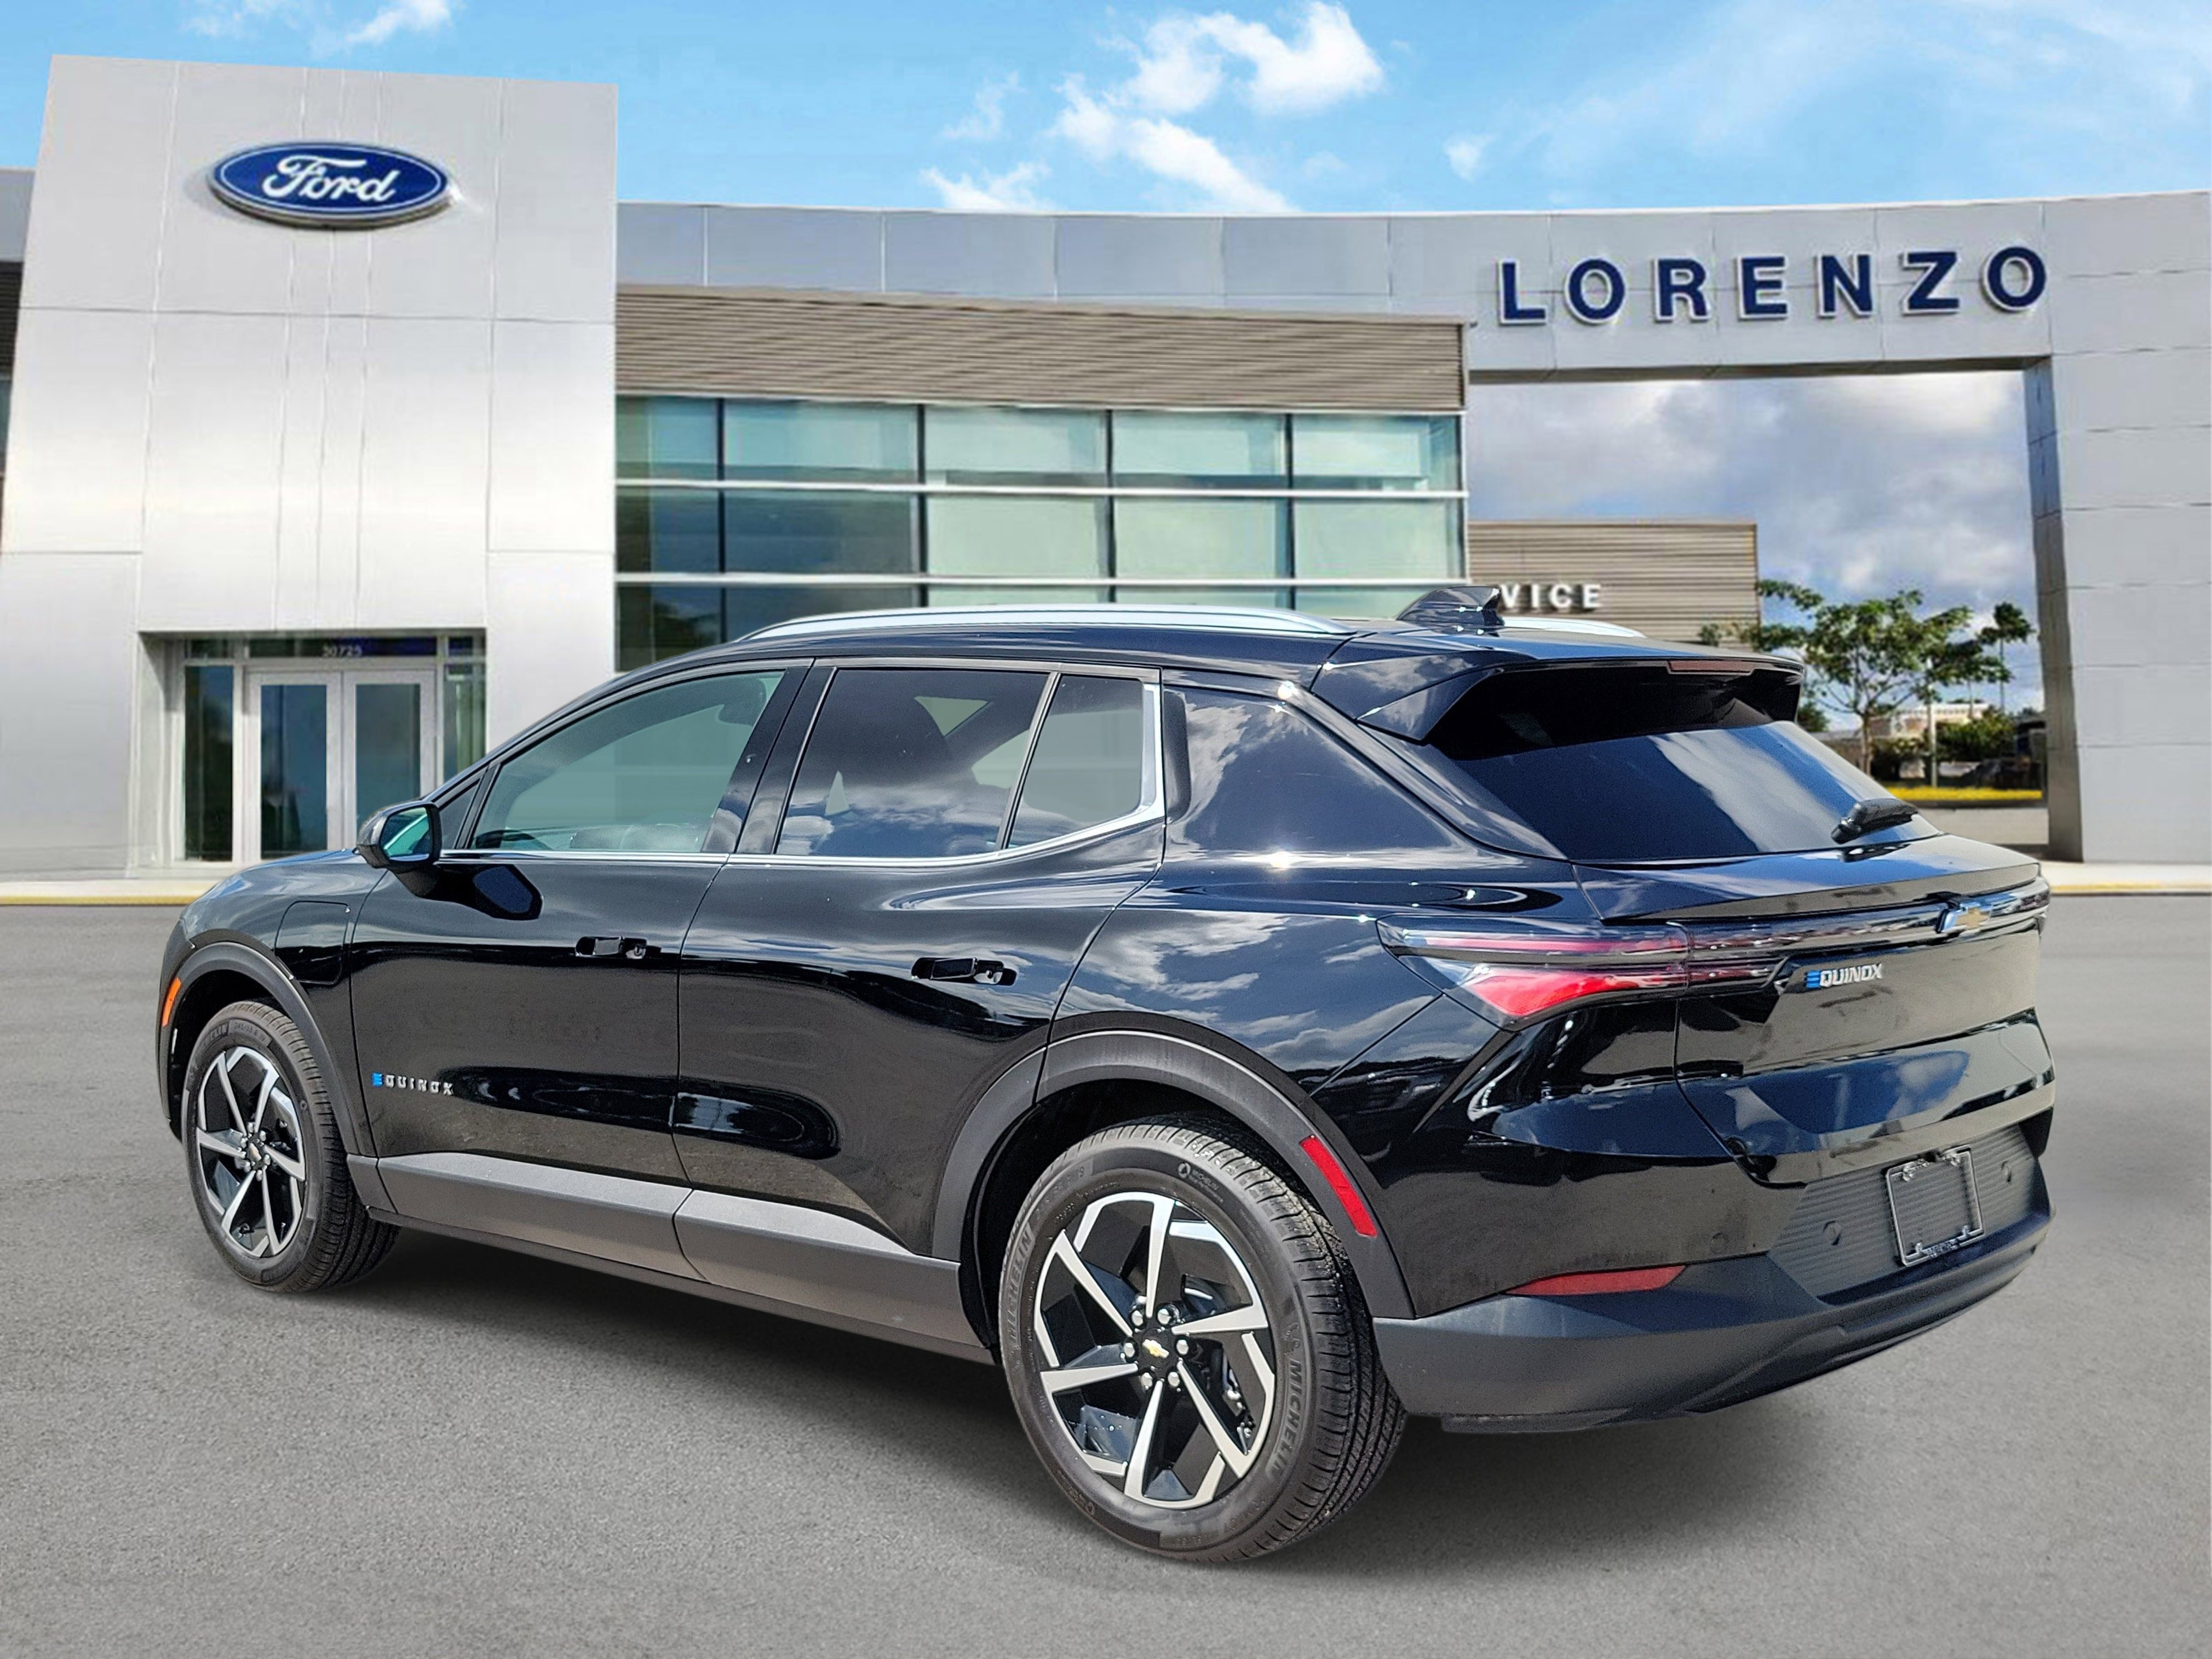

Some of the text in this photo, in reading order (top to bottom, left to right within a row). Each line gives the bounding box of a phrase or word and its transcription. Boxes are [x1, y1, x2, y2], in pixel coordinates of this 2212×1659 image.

[262, 154, 400, 202] Ford
[1497, 244, 2048, 325] LORENZO
[1805, 963, 1883, 989] EQUINOX
[371, 1072, 453, 1096] EQUINOX
[1272, 1358, 1302, 1477] MICHELIN
